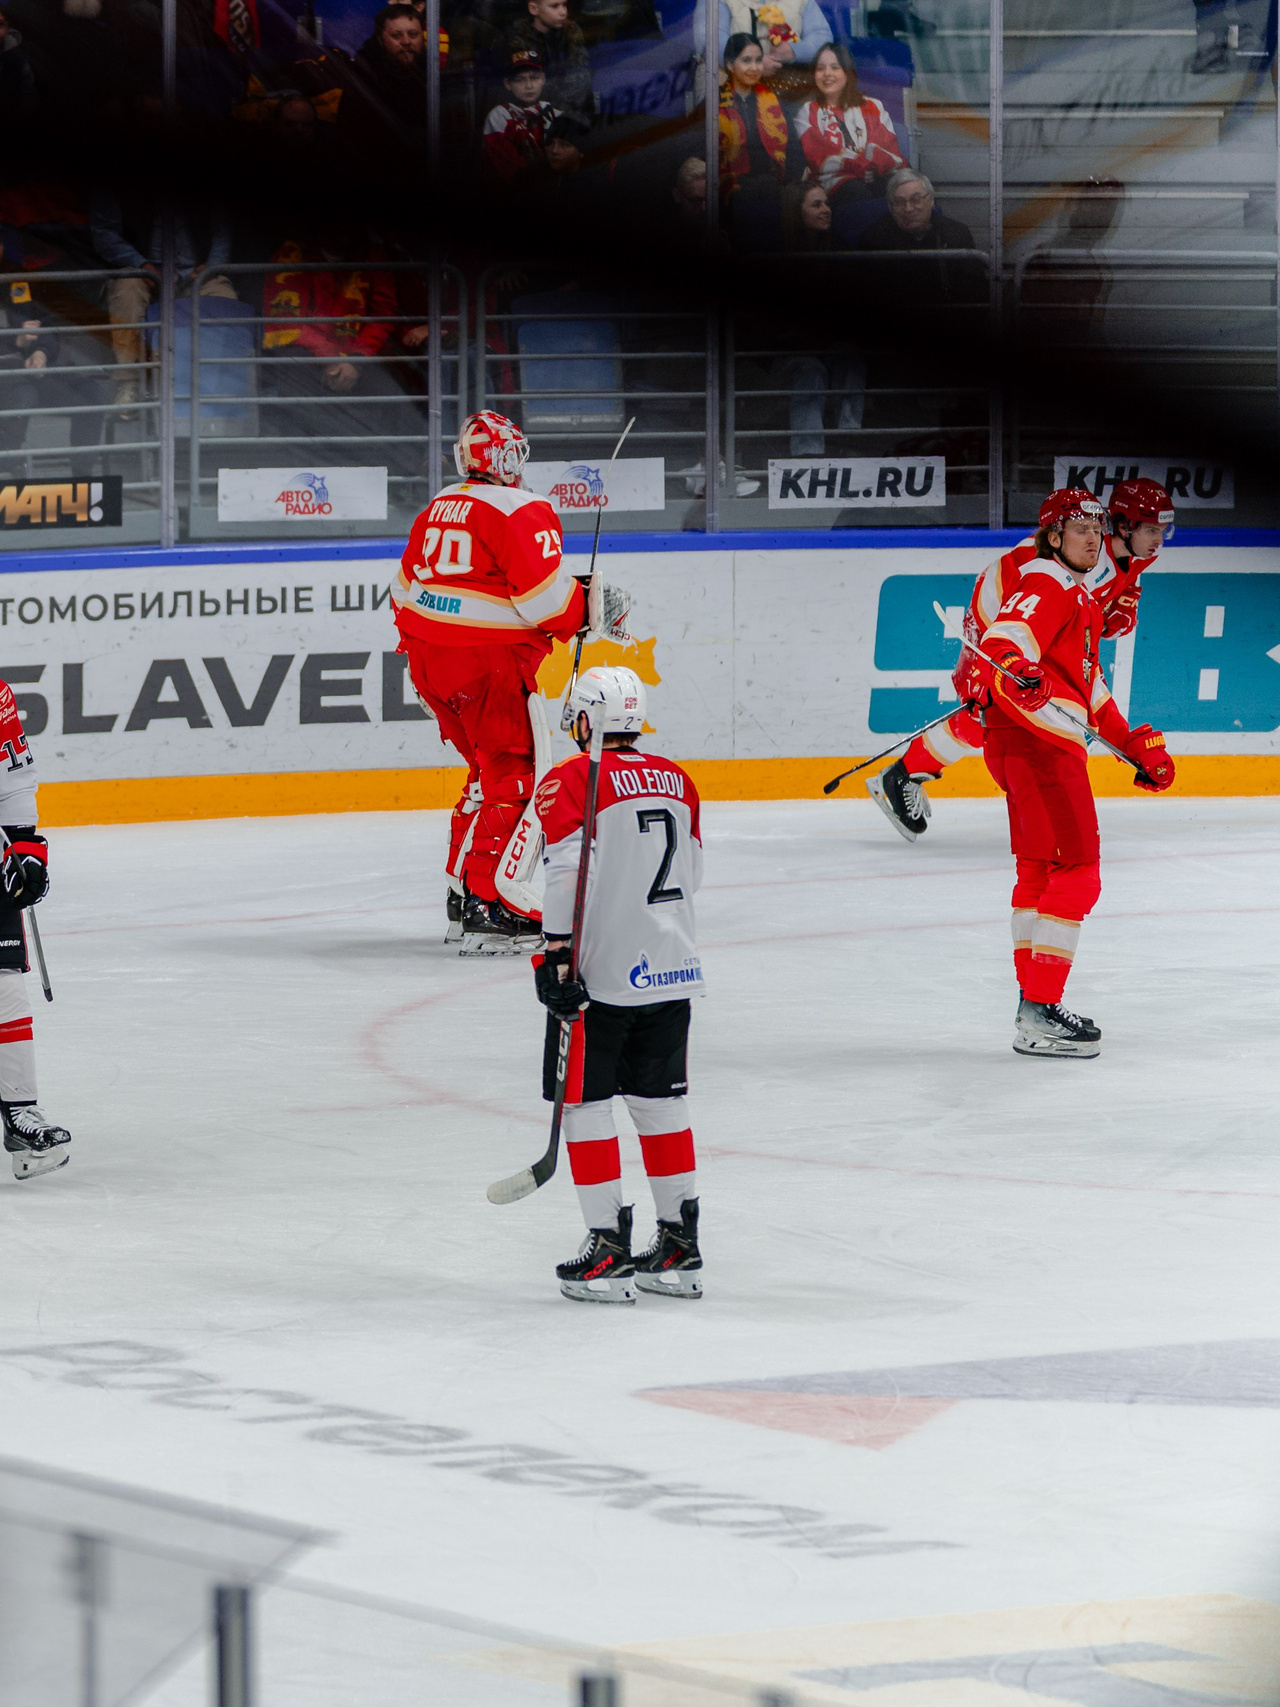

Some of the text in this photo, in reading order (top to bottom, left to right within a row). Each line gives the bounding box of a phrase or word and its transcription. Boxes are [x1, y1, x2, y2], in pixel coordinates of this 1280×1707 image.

[548, 482, 587, 497] АВТО
[779, 466, 935, 499] KHL.RU
[1066, 465, 1223, 499] KHRU
[275, 490, 312, 503] АВТО
[285, 502, 332, 516] РАДИО
[559, 494, 609, 509] РАДИО
[428, 500, 473, 523] RYBAR
[535, 530, 562, 559] 29
[417, 591, 462, 614] SIBUR
[1000, 592, 1040, 619] 94
[624, 717, 634, 730] 2
[609, 768, 684, 799] KOLEDOV
[505, 819, 532, 880] CCM
[635, 807, 684, 905] 2
[583, 1254, 614, 1280] CCM
